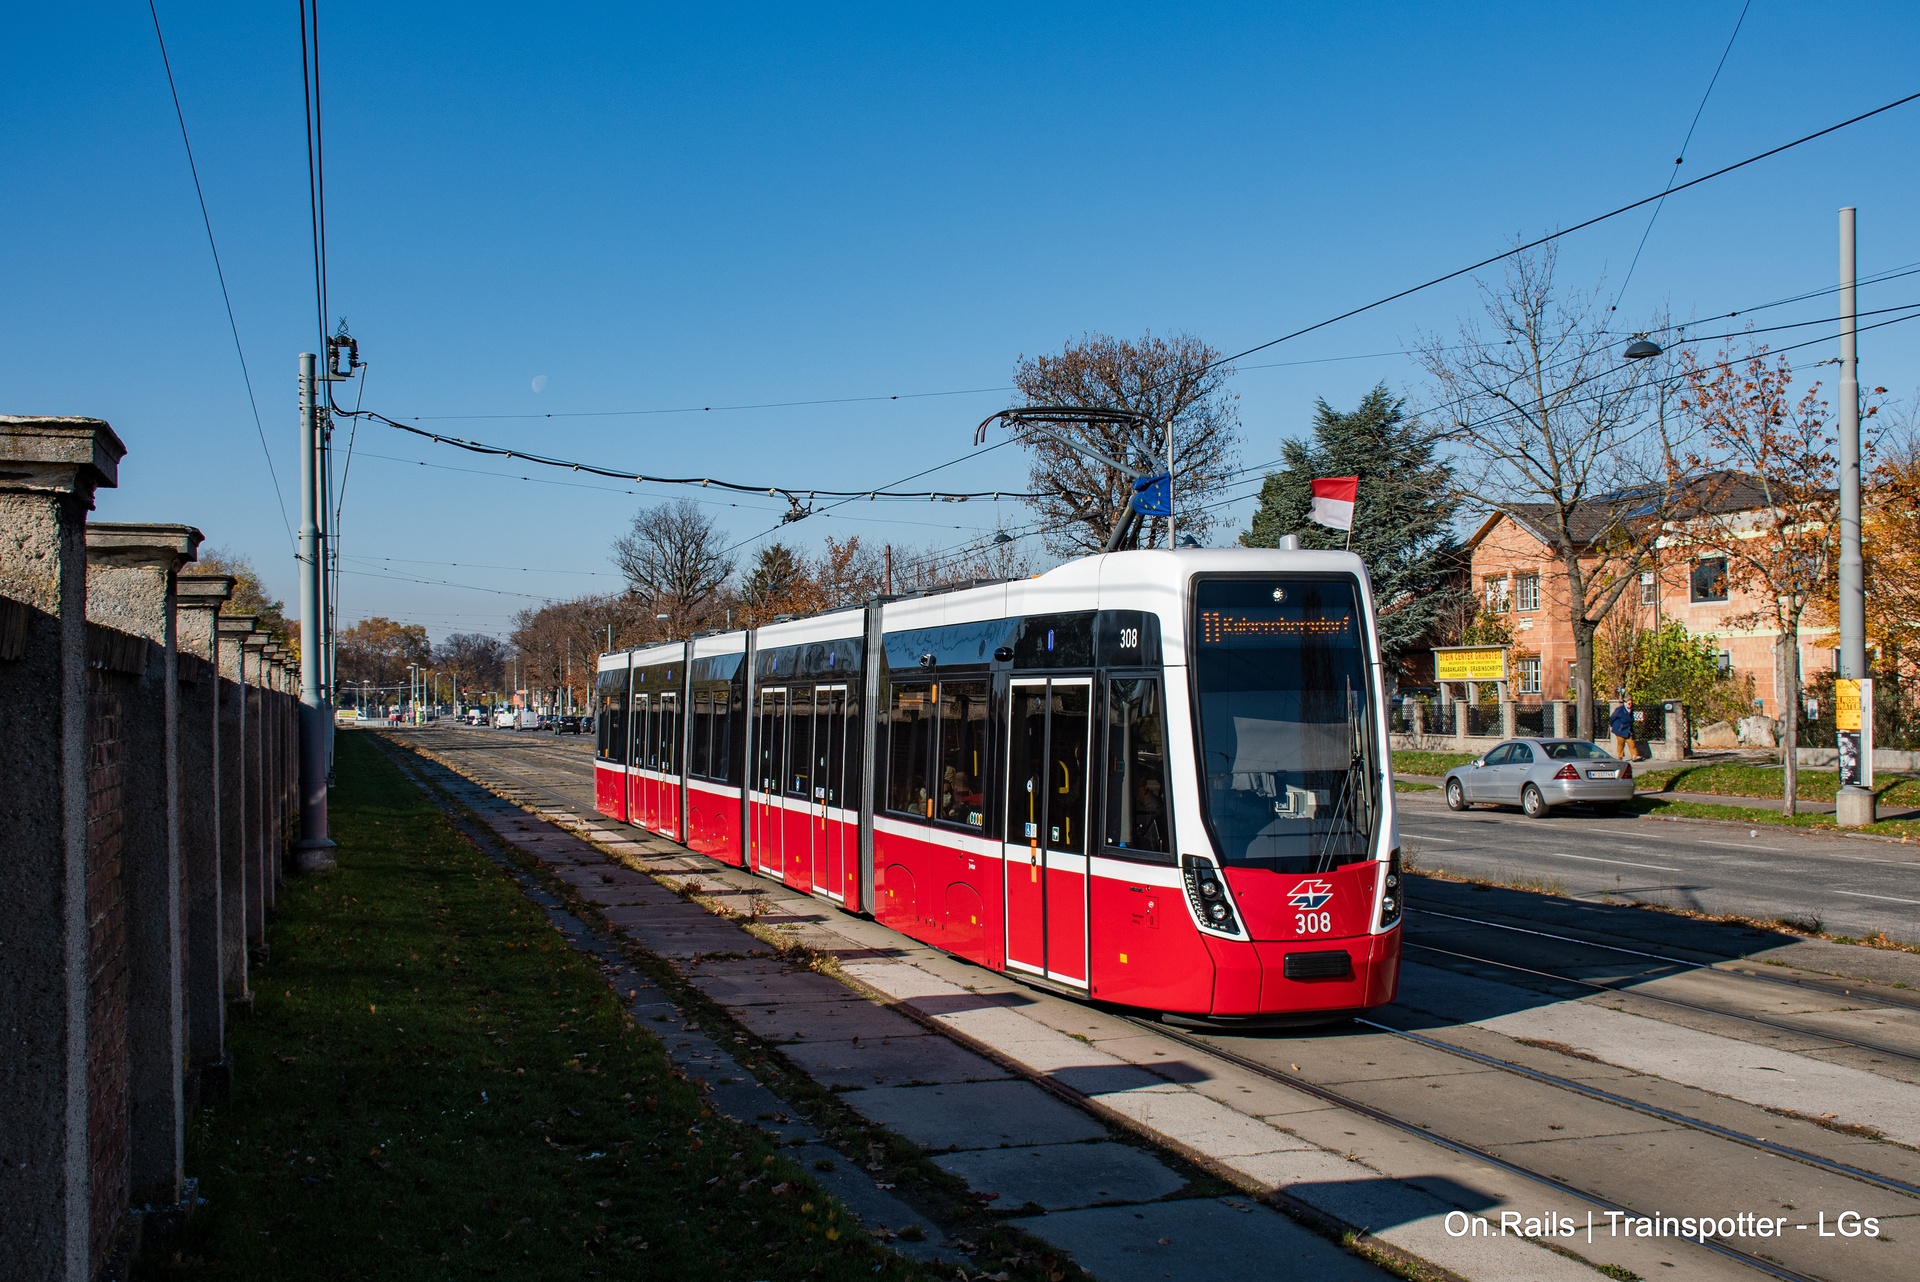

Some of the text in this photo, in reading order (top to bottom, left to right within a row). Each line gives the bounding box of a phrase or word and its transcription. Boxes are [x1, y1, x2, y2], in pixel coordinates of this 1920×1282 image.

[1201, 612, 1220, 642] 11
[1120, 628, 1138, 648] 308
[1440, 652, 1453, 661] STEIN
[1455, 652, 1473, 660] CENTER
[1295, 911, 1331, 934] 308
